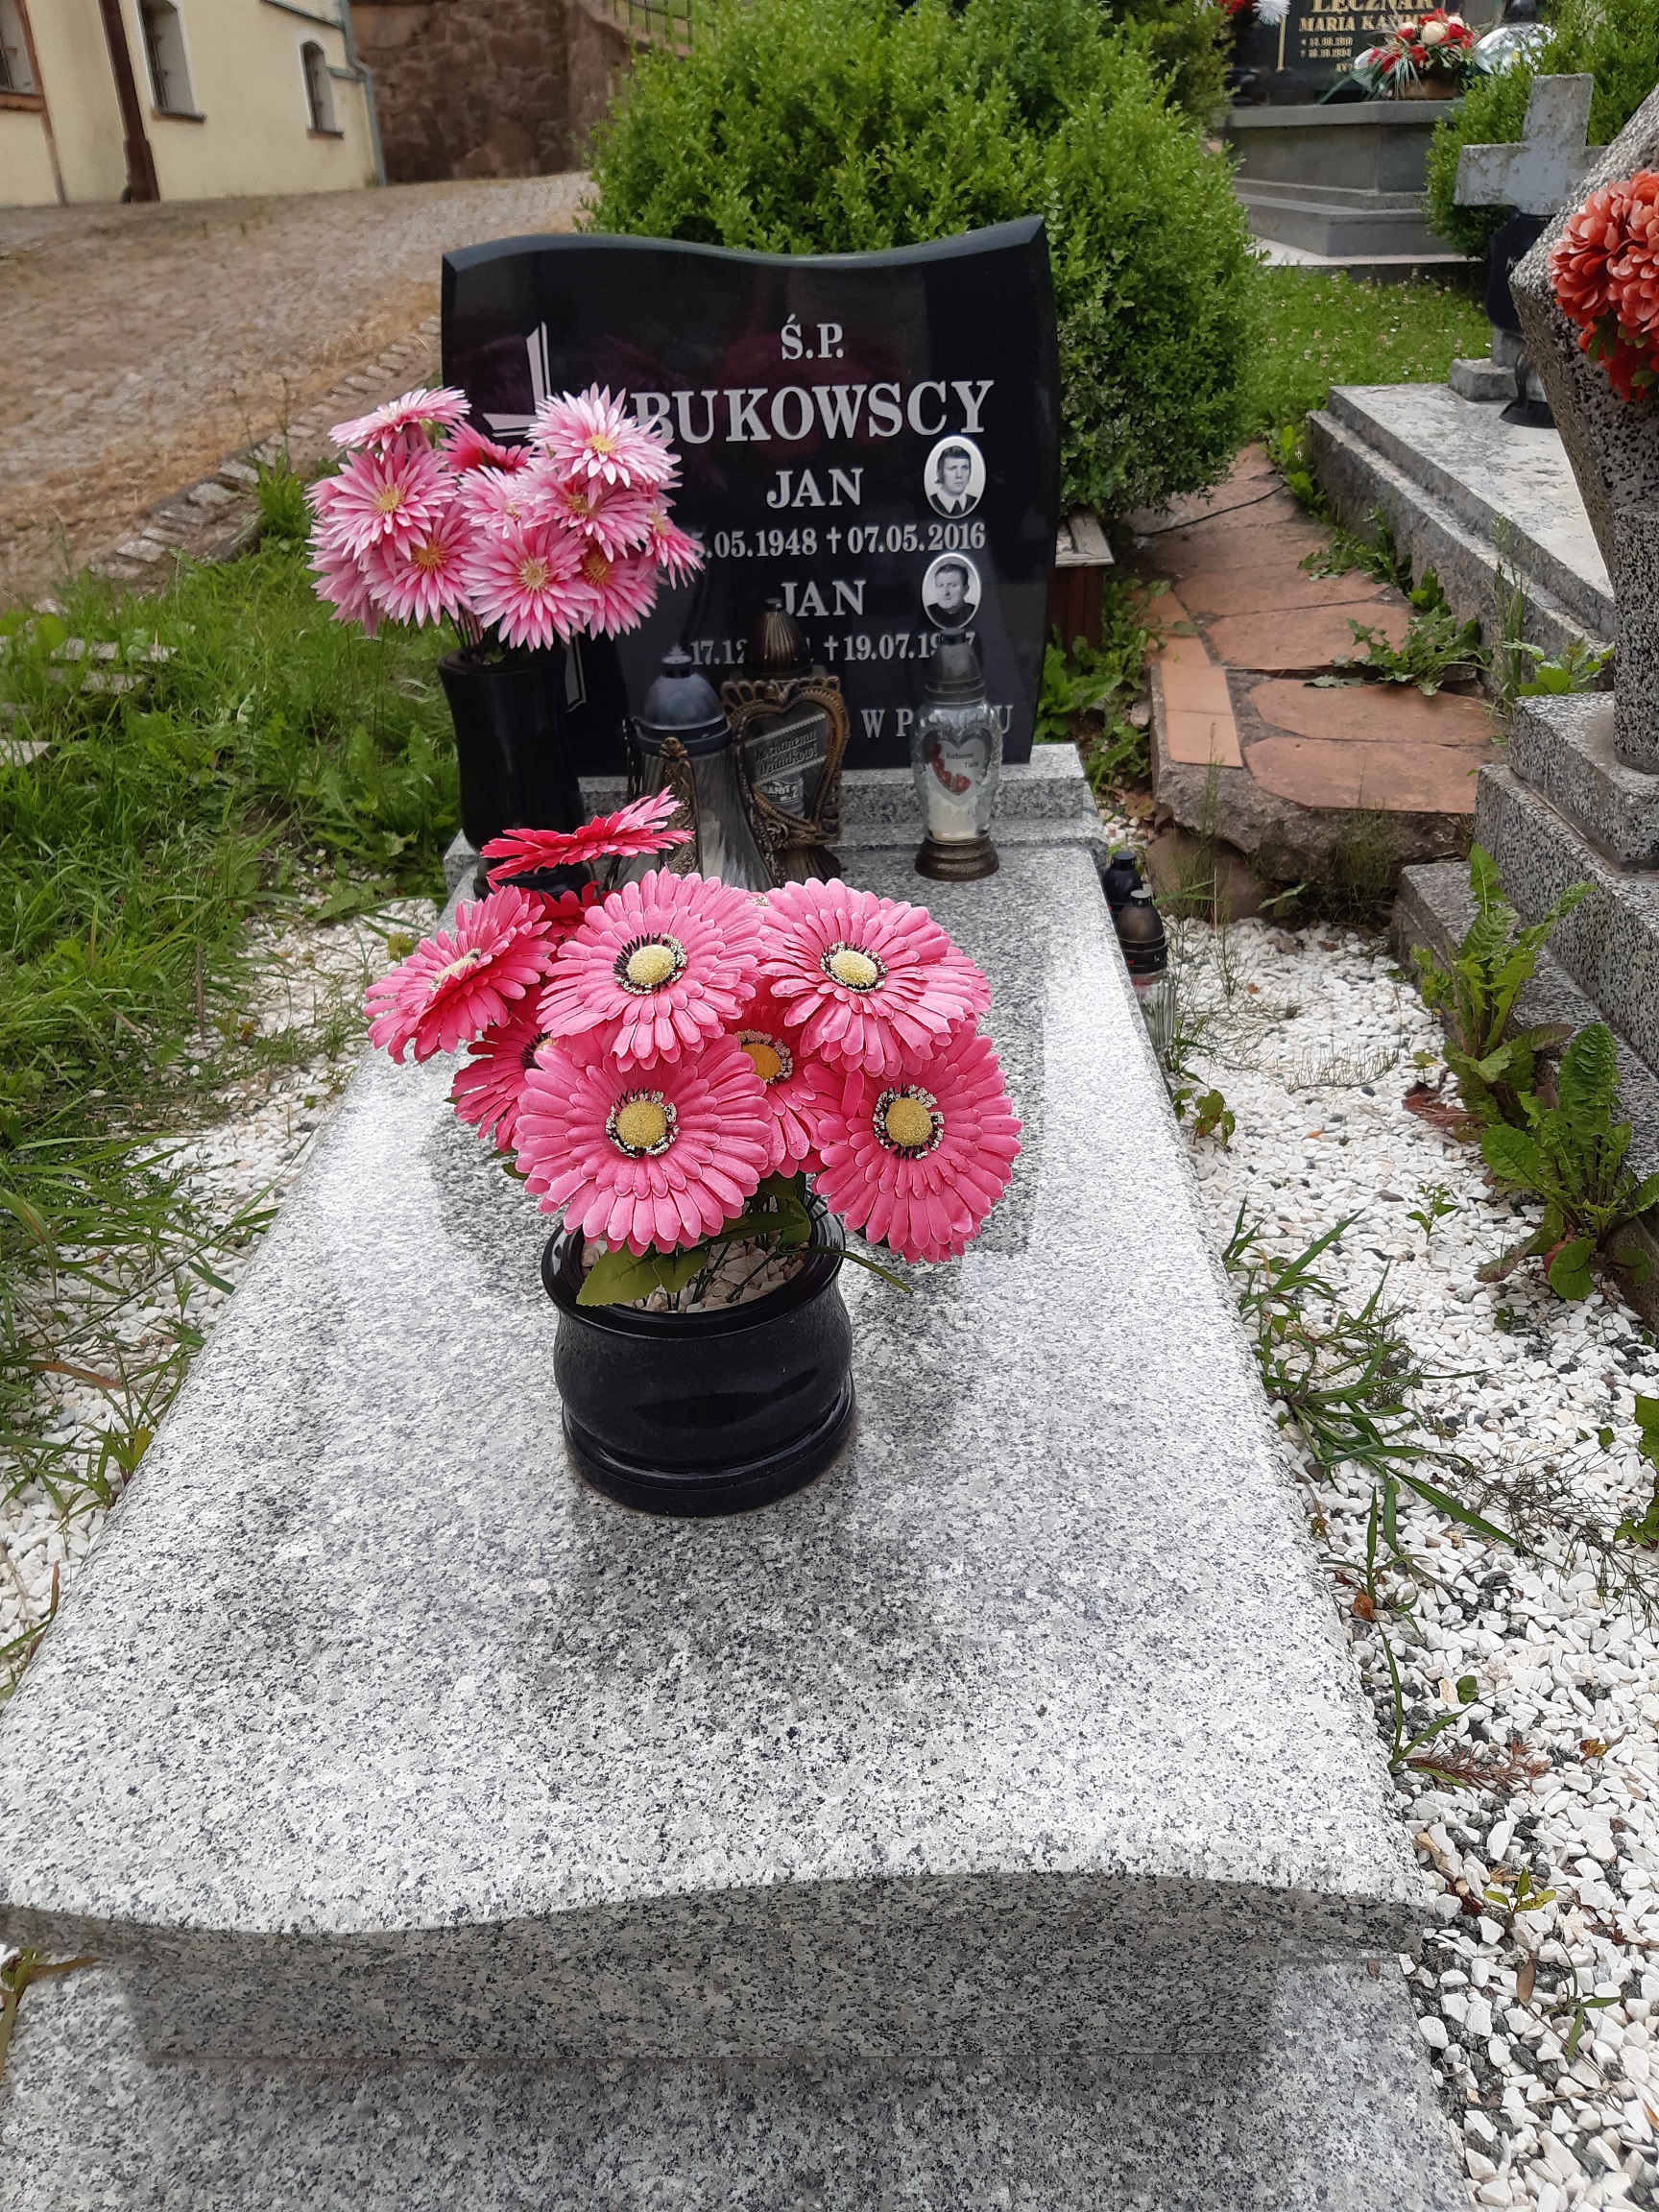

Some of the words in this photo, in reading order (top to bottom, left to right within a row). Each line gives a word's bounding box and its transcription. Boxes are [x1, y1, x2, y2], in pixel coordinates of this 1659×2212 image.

[1298, 15, 1356, 32] MARIA
[780, 313, 844, 360] Ś.P.
[630, 379, 995, 445] BUKOWSCY
[766, 468, 864, 509] JAN
[689, 527, 817, 560] 5.05.1948
[847, 521, 986, 554] 07.05.2016
[781, 580, 866, 617] JAN
[844, 632, 976, 661] 19.07.197
[860, 709, 886, 738] W
